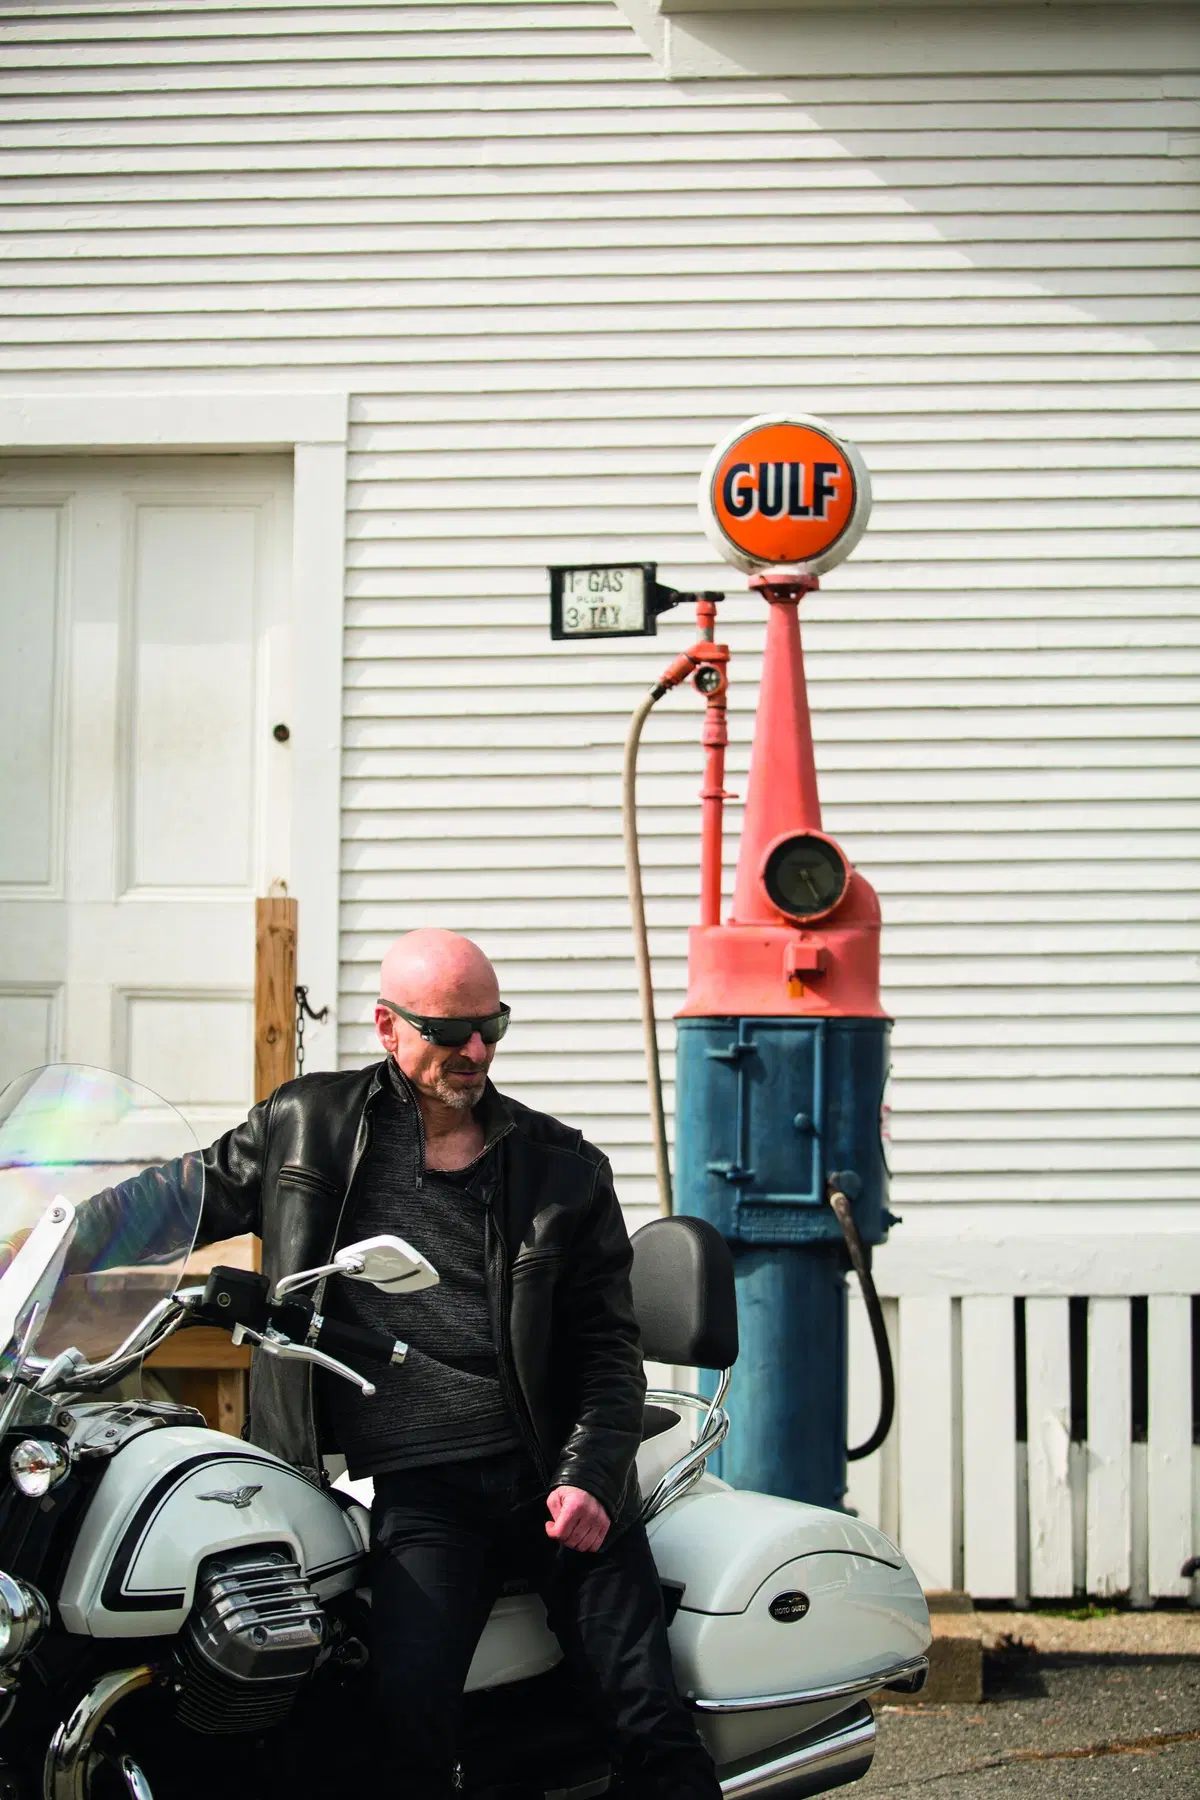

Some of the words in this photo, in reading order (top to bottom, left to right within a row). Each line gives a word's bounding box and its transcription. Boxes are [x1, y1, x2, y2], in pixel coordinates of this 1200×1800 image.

[722, 462, 843, 522] GULF
[588, 569, 624, 593] GAS
[273, 1634, 290, 1642] MOTO
